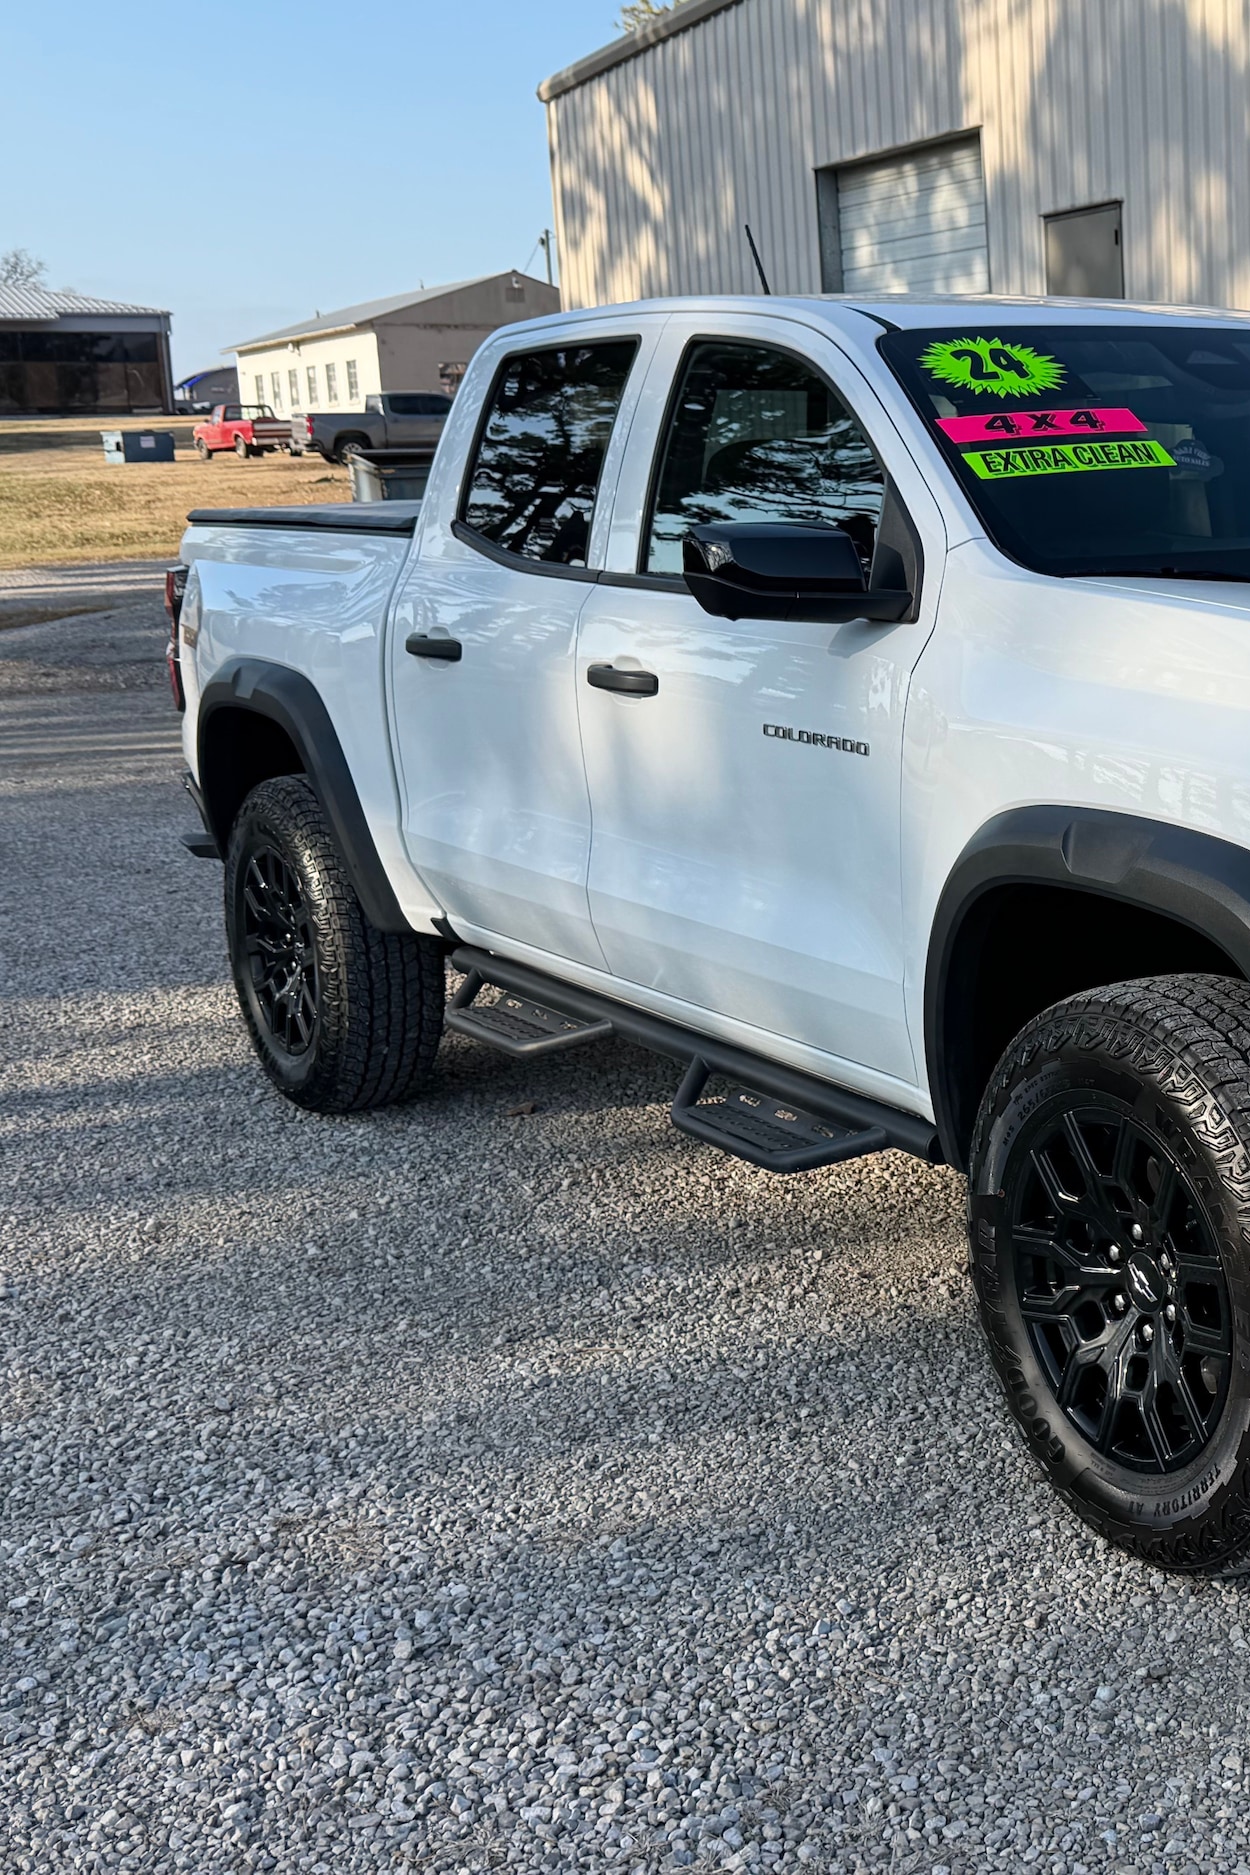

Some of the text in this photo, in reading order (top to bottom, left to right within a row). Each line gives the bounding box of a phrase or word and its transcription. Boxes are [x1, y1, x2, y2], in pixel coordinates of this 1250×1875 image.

[950, 348, 1032, 381] 24
[981, 448, 1072, 474] EXTRA
[1072, 441, 1158, 468] CLEAN
[763, 723, 870, 756] COLORADO
[1154, 1463, 1221, 1517] TERRITORY
